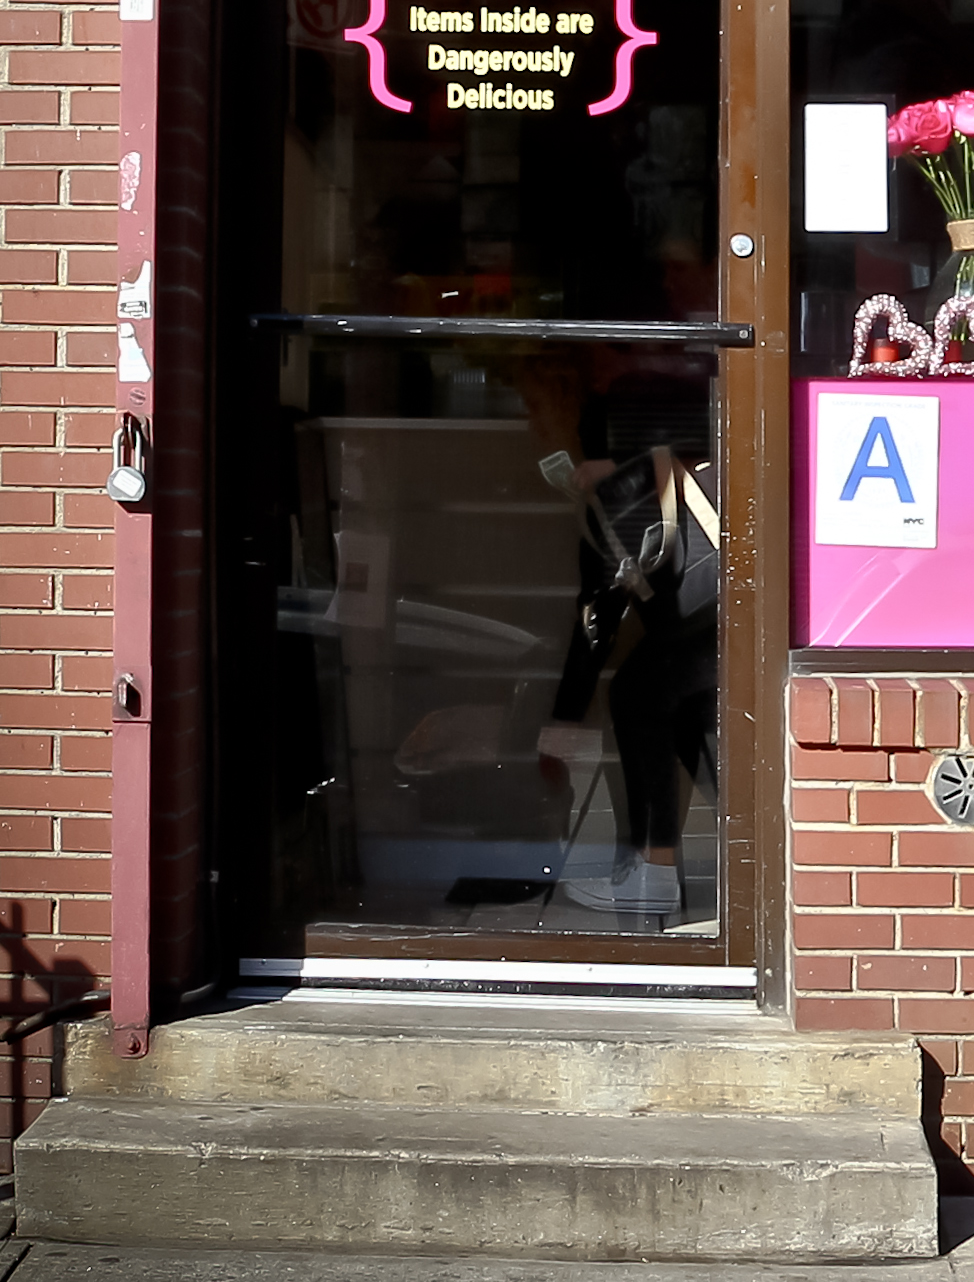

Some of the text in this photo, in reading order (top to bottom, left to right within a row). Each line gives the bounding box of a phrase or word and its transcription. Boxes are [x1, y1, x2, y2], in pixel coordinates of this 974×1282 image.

[409, 5, 595, 35] Items Inside are
[427, 44, 576, 78] Dangerously
[446, 82, 555, 111] Delicious
[838, 416, 916, 504] A
